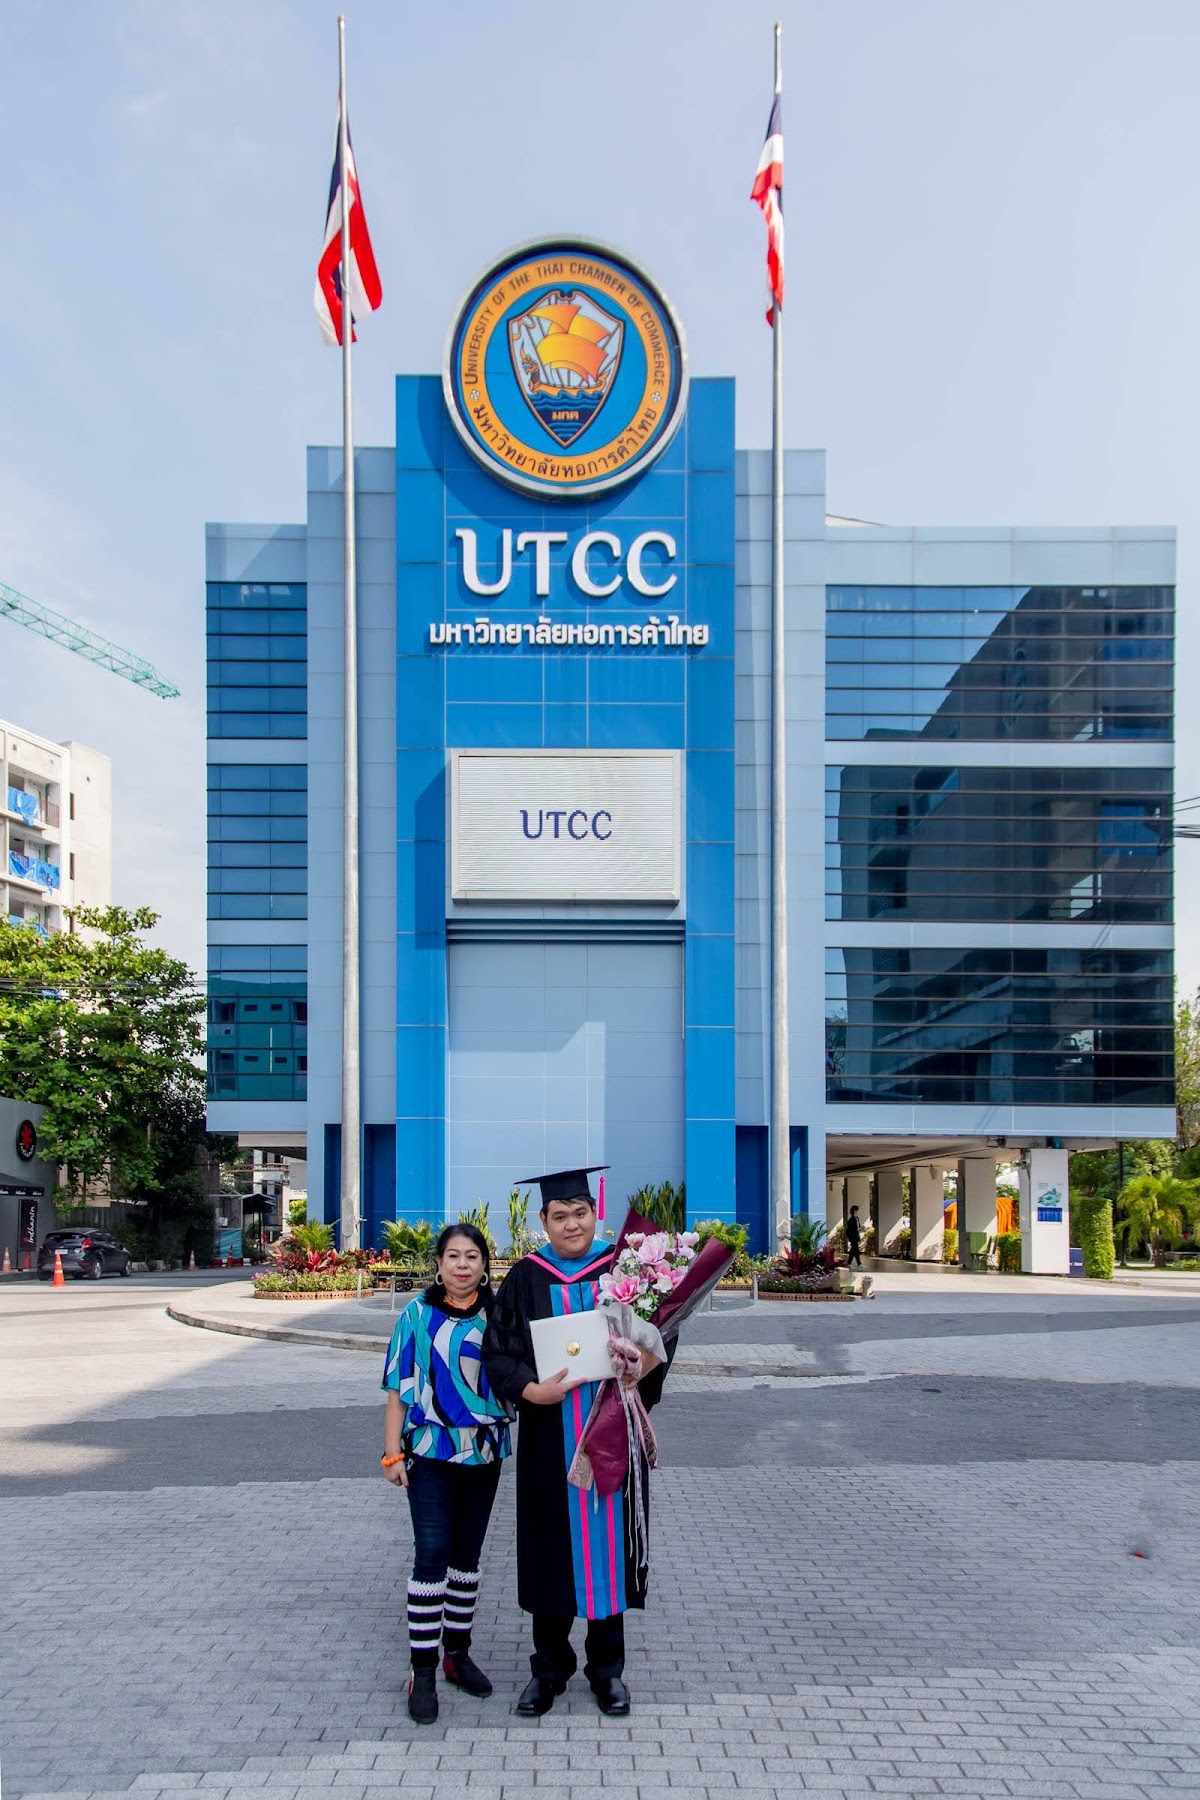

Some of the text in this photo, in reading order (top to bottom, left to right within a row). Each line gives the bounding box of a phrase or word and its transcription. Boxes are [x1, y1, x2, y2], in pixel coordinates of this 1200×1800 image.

[464, 262, 665, 386] UNIVERSITY OF THE THAI CHAMBER OF COMMERCE
[455, 528, 678, 597] UTCC
[429, 615, 709, 645] มหาวิทยาลัยหอการค้าไทย
[519, 809, 612, 840] UTCC
